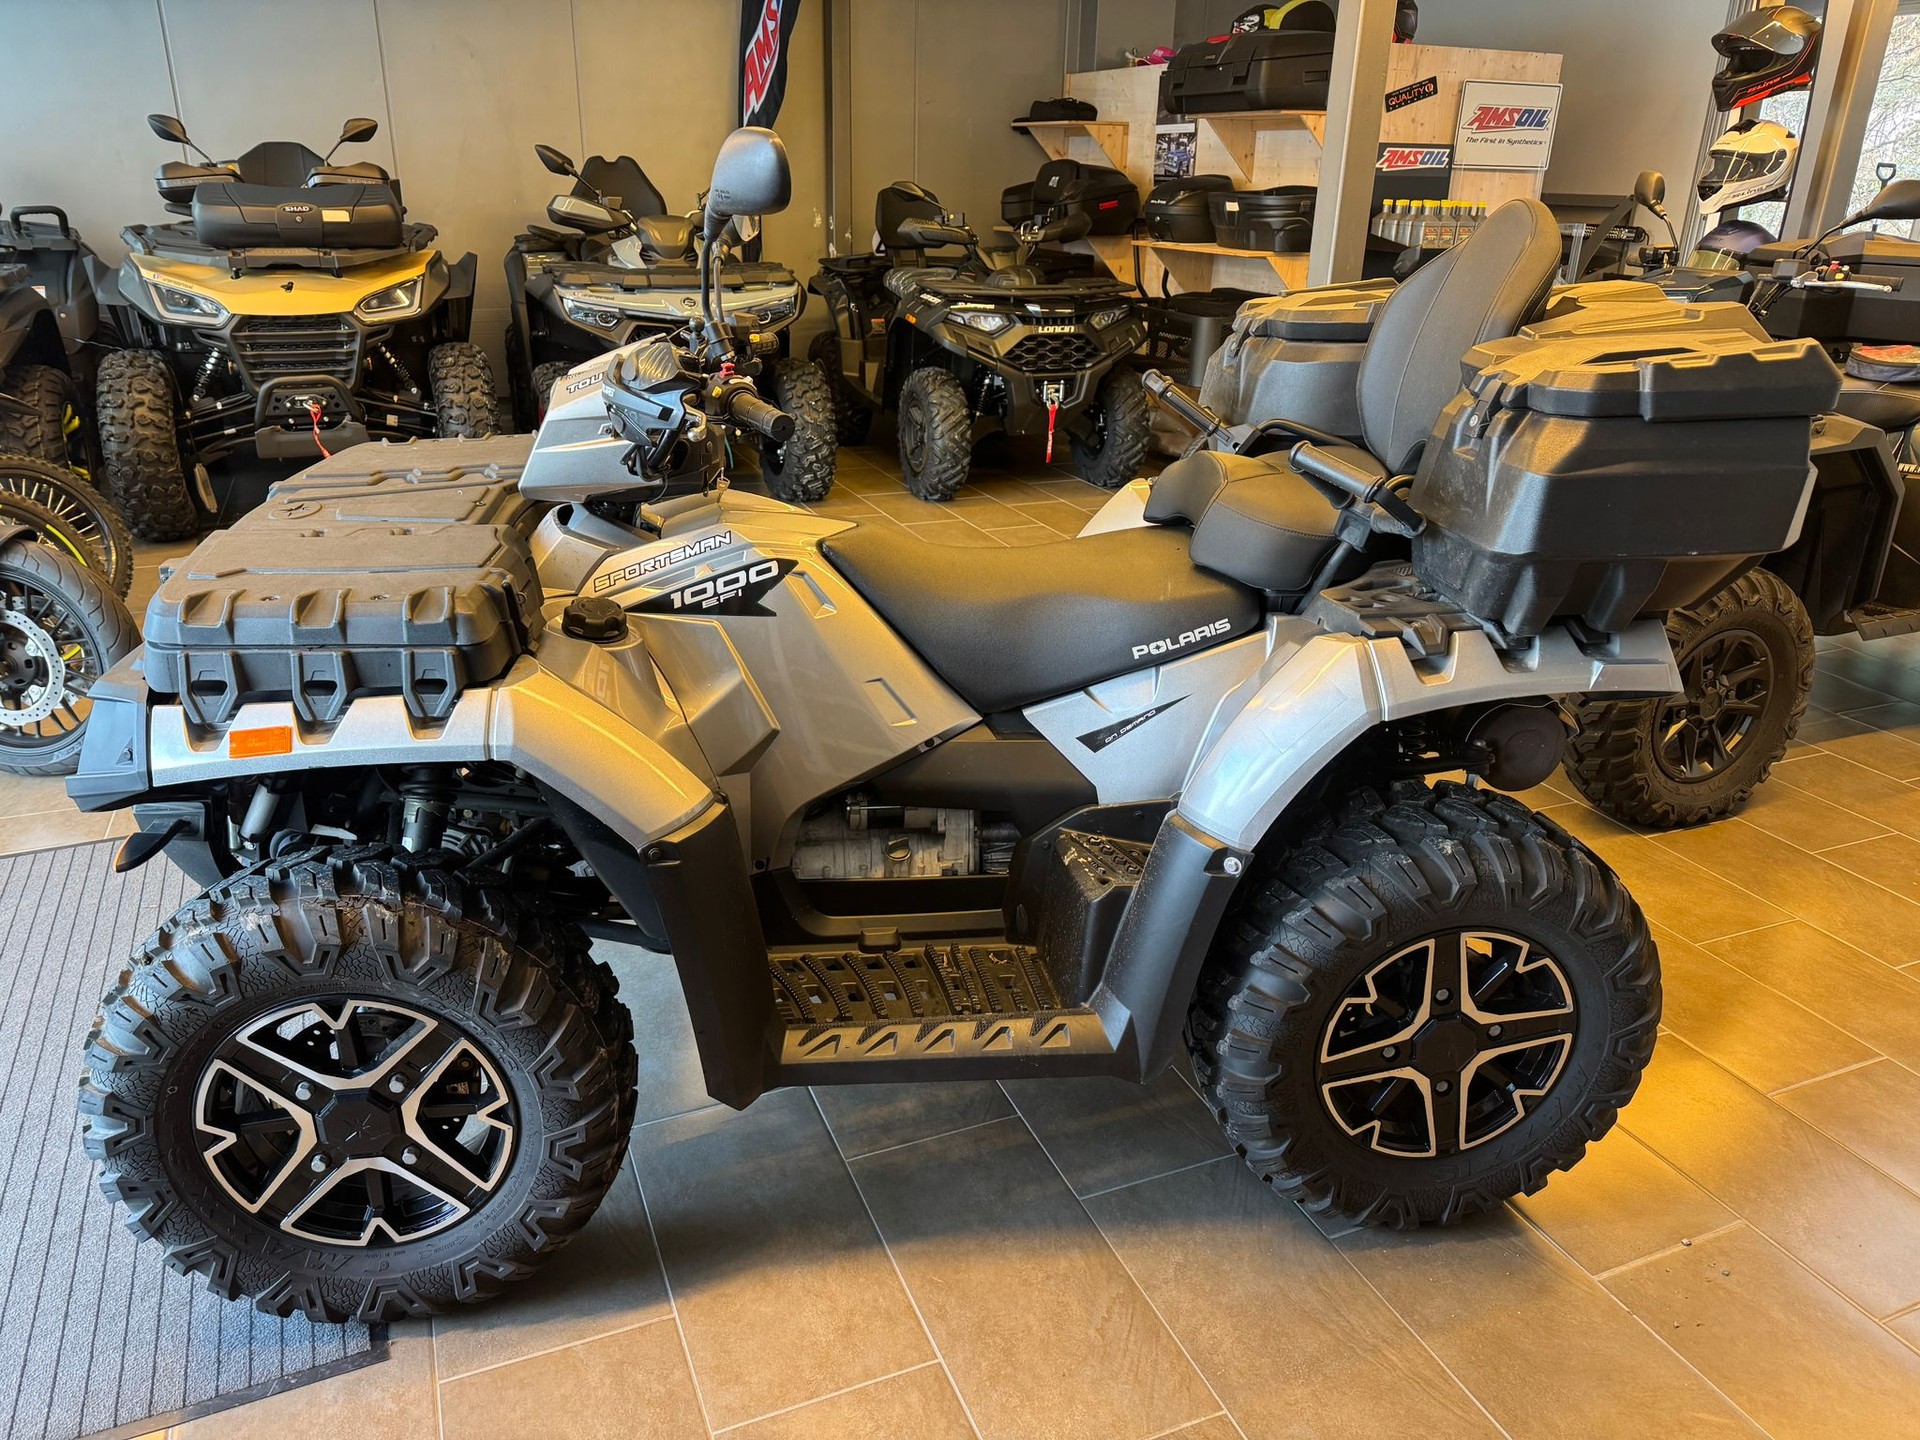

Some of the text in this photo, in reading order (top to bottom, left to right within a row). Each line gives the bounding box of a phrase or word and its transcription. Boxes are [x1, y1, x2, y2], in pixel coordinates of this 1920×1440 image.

[744, 0, 780, 122] AMS
[1389, 86, 1425, 106] QUALITY
[1466, 106, 1549, 131] AMSOIL
[1506, 138, 1543, 146] Synthetics
[1378, 149, 1449, 170] AMSOIL
[566, 371, 604, 395] TOU
[593, 530, 732, 593] SPORTSMAN
[670, 560, 779, 610] 1000
[702, 588, 743, 609] EFI
[1131, 618, 1232, 660] POLARIS
